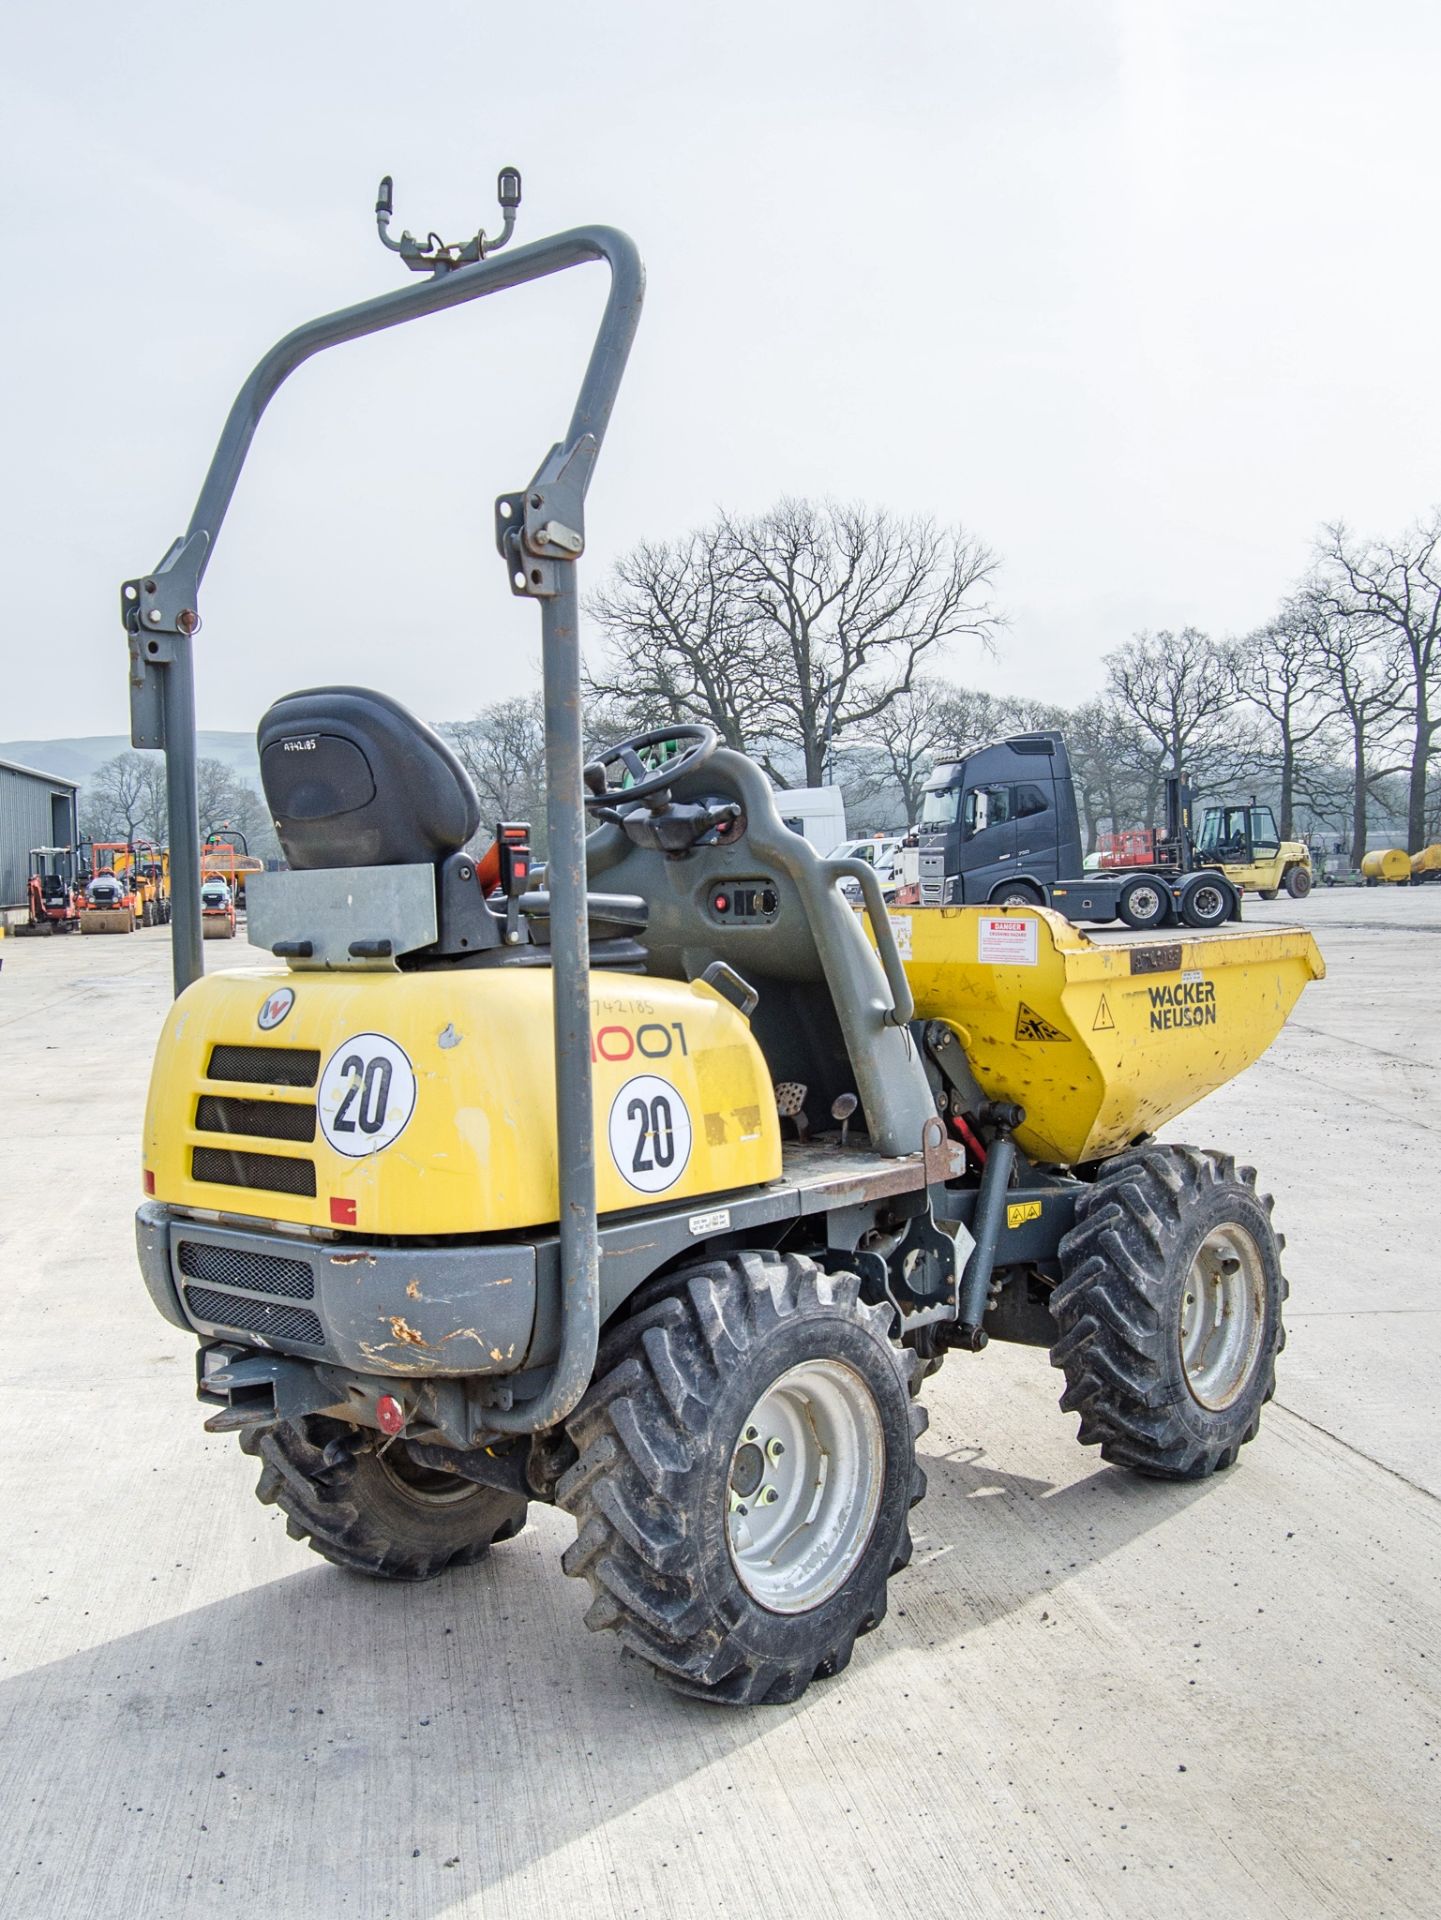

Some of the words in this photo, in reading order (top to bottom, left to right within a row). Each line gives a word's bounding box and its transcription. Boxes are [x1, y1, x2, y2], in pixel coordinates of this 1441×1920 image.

[994, 922, 1022, 931] DANGER
[1148, 981, 1216, 1008] WACKER
[1150, 1003, 1216, 1031] NEUSON
[333, 1054, 393, 1134] 20
[626, 1095, 675, 1173] 20
